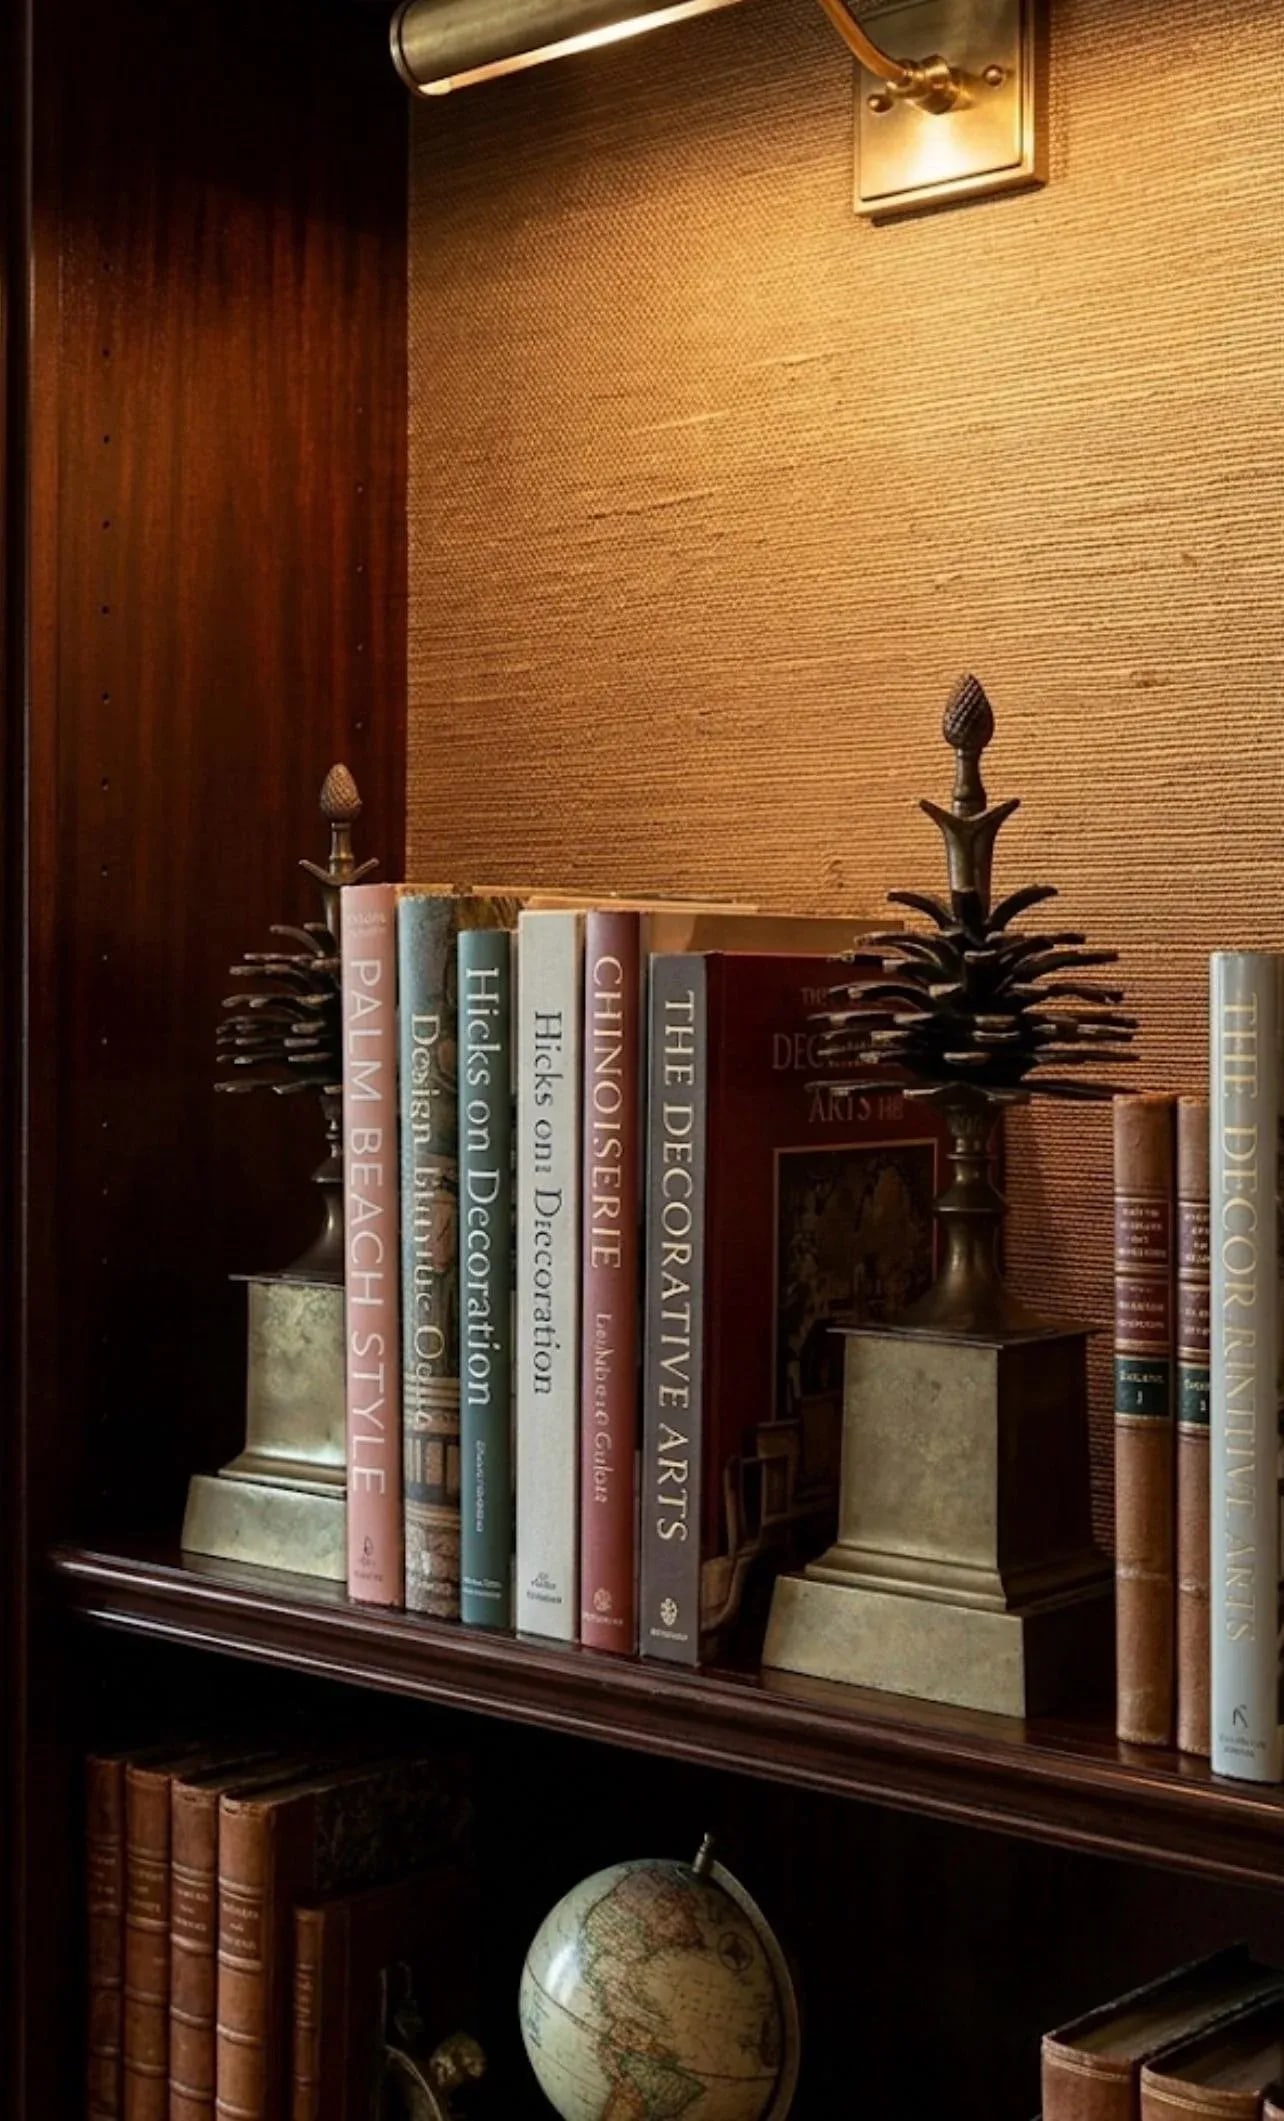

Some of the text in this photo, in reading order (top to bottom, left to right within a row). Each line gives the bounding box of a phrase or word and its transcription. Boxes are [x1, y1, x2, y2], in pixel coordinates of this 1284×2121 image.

[350, 959, 382, 1101] PALM
[534, 1011, 564, 1107] Hicks
[592, 956, 623, 1268] CHINOISERIE
[1222, 992, 1258, 1098] THE
[351, 1127, 384, 1306] BEACH
[465, 967, 501, 1405] Hicks on Decoration
[656, 989, 695, 1541] THE DECORATIVE ARTS
[351, 1330, 386, 1494] STYLE
[1224, 1531, 1257, 1643] ARTS
